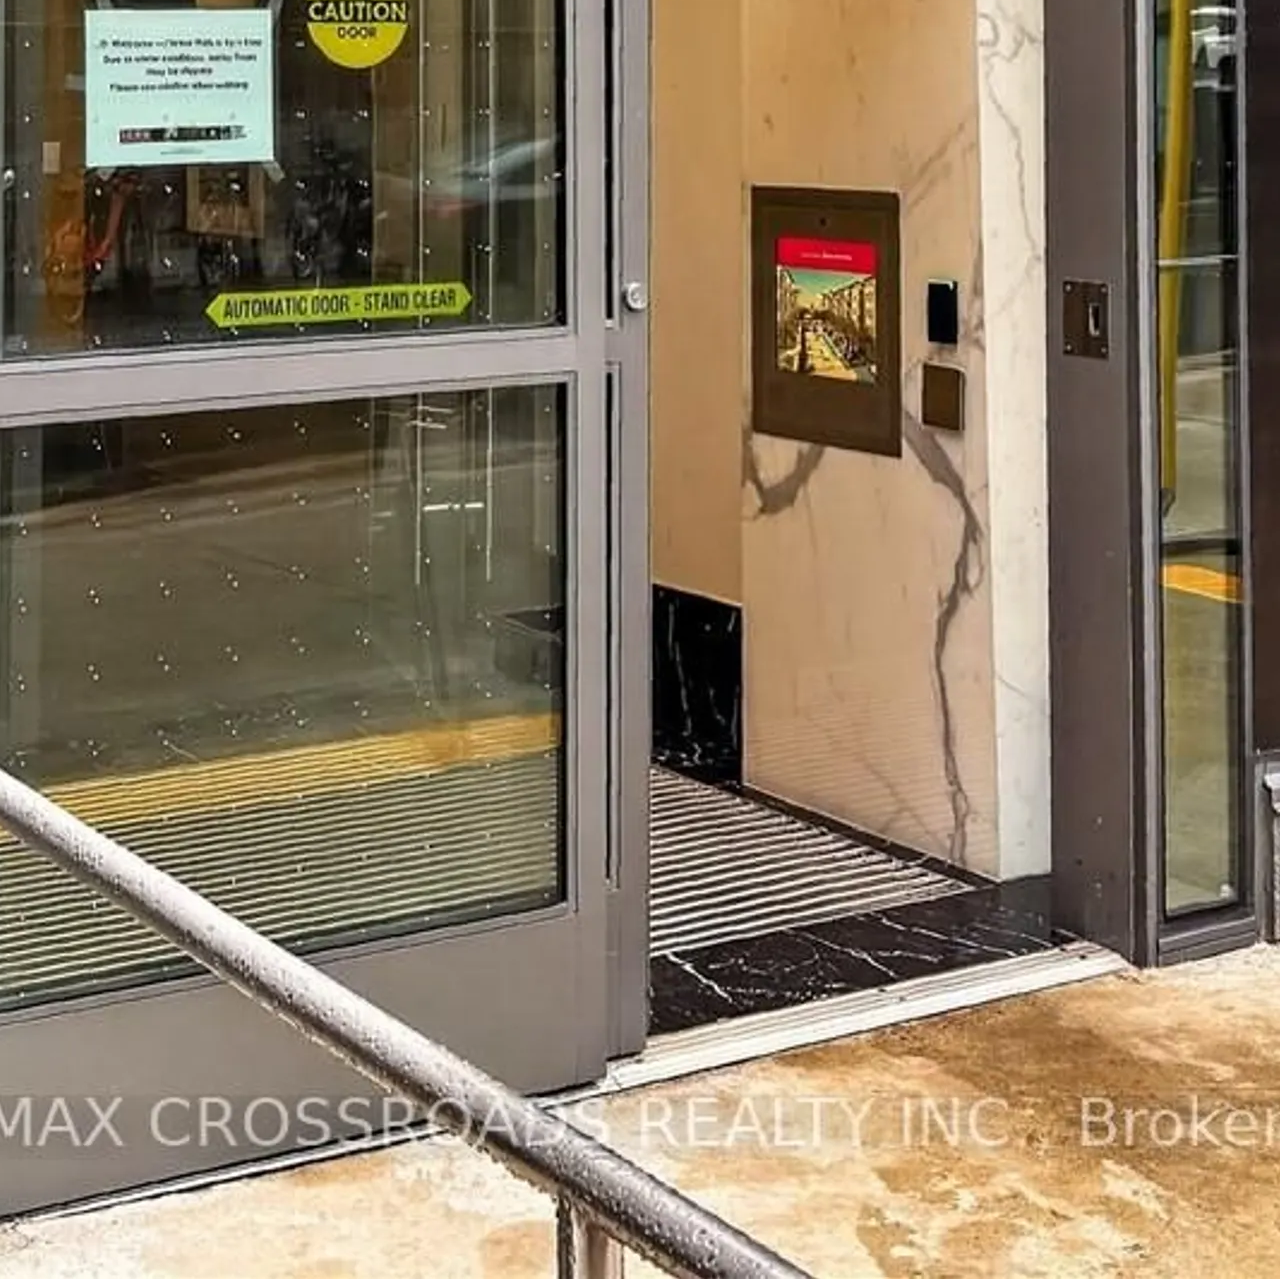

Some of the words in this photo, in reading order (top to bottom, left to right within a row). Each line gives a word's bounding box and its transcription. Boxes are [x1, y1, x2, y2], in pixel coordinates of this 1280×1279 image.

[308, 2, 407, 21] CAUTION
[337, 25, 378, 40] DOOR
[223, 298, 308, 319] AUTOMATIC
[311, 294, 351, 314] DOOR
[363, 291, 410, 312] STAND
[411, 288, 457, 309] CLEAR
